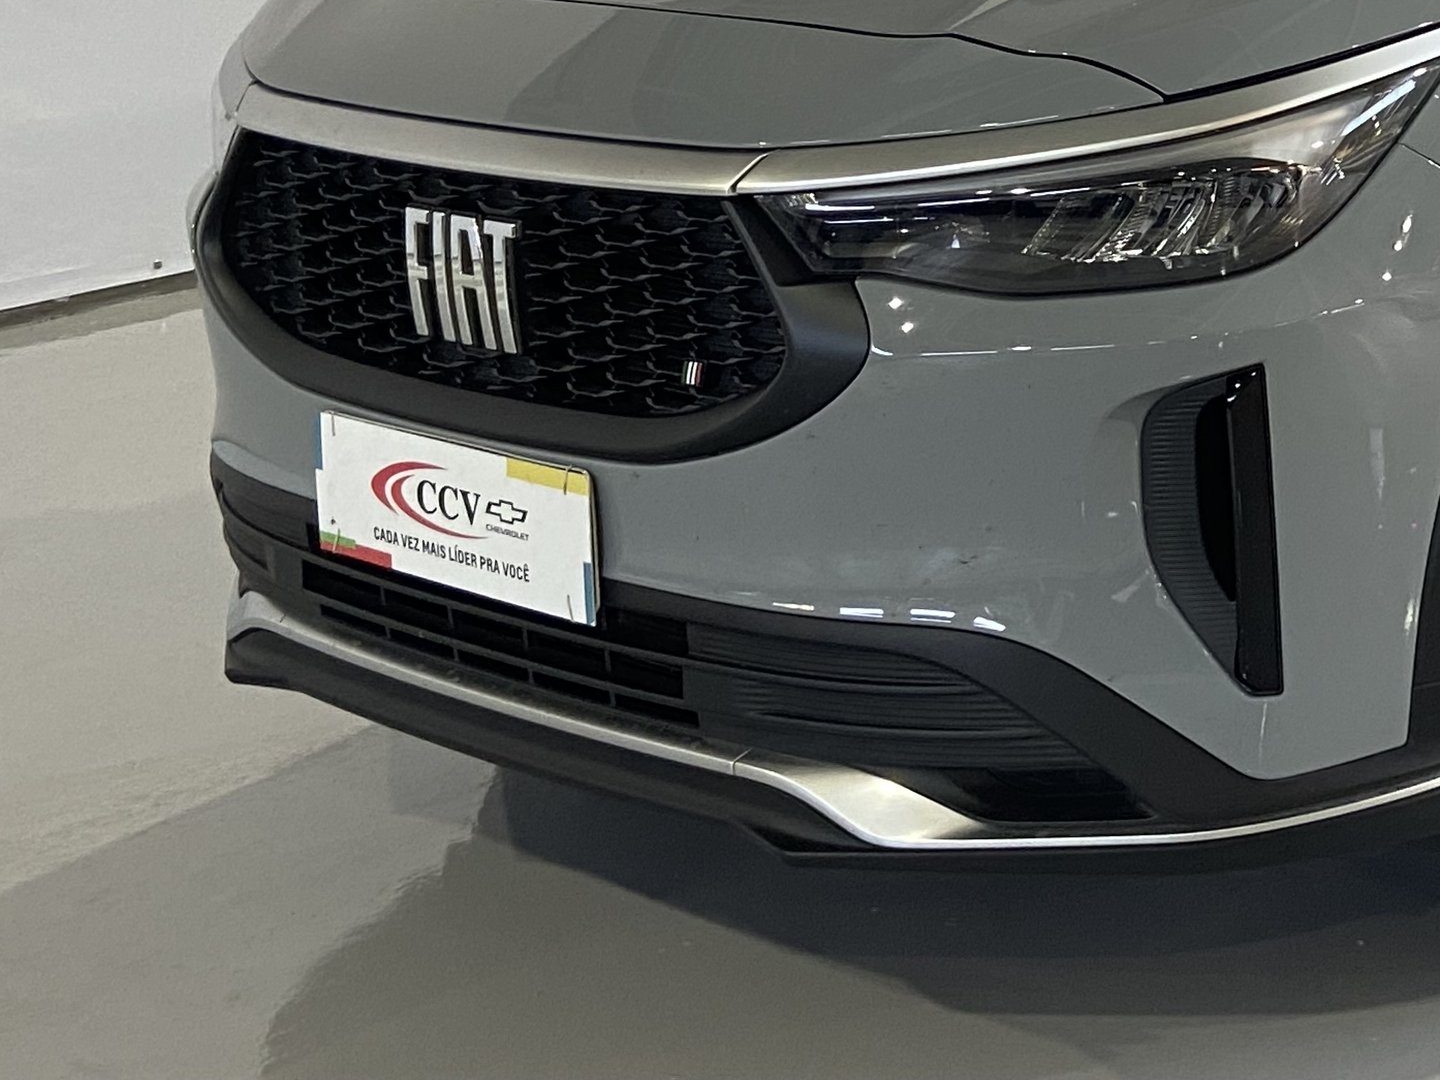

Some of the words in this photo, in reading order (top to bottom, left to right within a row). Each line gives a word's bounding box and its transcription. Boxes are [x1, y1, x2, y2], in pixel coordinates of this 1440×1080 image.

[405, 207, 518, 354] FIAT
[416, 479, 481, 526] CCV
[373, 526, 399, 547] CADA
[400, 533, 420, 552] VEZ
[422, 540, 446, 559] MAIS
[448, 544, 477, 568] LÍDER
[479, 556, 501, 575] PRA
[502, 563, 530, 583] VOCÊ
